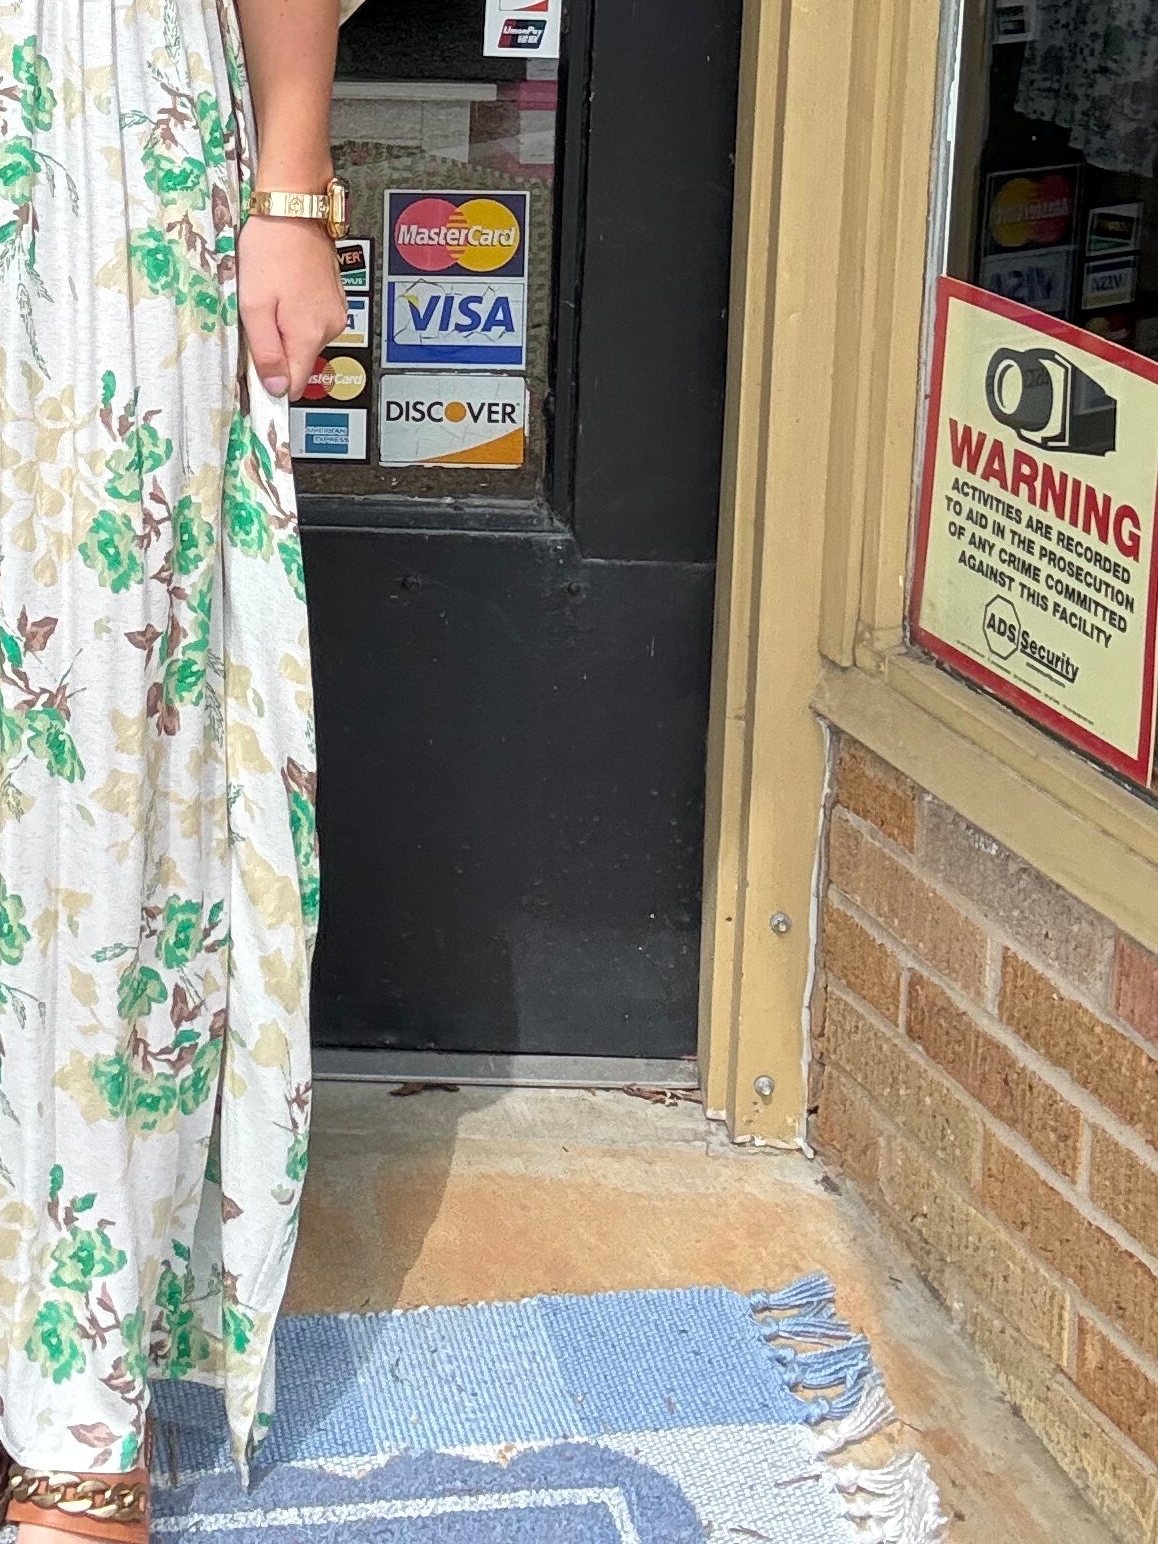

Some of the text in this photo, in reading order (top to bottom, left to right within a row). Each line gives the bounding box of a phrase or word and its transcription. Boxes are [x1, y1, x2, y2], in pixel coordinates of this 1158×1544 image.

[503, 25, 543, 38] UnionPay
[397, 224, 517, 247] MasterCard
[407, 295, 516, 333] VISA
[385, 401, 518, 424] DISCOVER
[949, 417, 1142, 563] WARNING
[951, 477, 1132, 585] ACTIVITIES ARE RECORDED
[945, 495, 1135, 614] TO AID IN THE PROSECUTION
[948, 521, 1128, 634] OF ANY CRIME COMMITTED
[958, 550, 1113, 649] AGAINST THIS FACILITY
[986, 613, 1017, 645] ADS
[1020, 630, 1080, 680] Security
